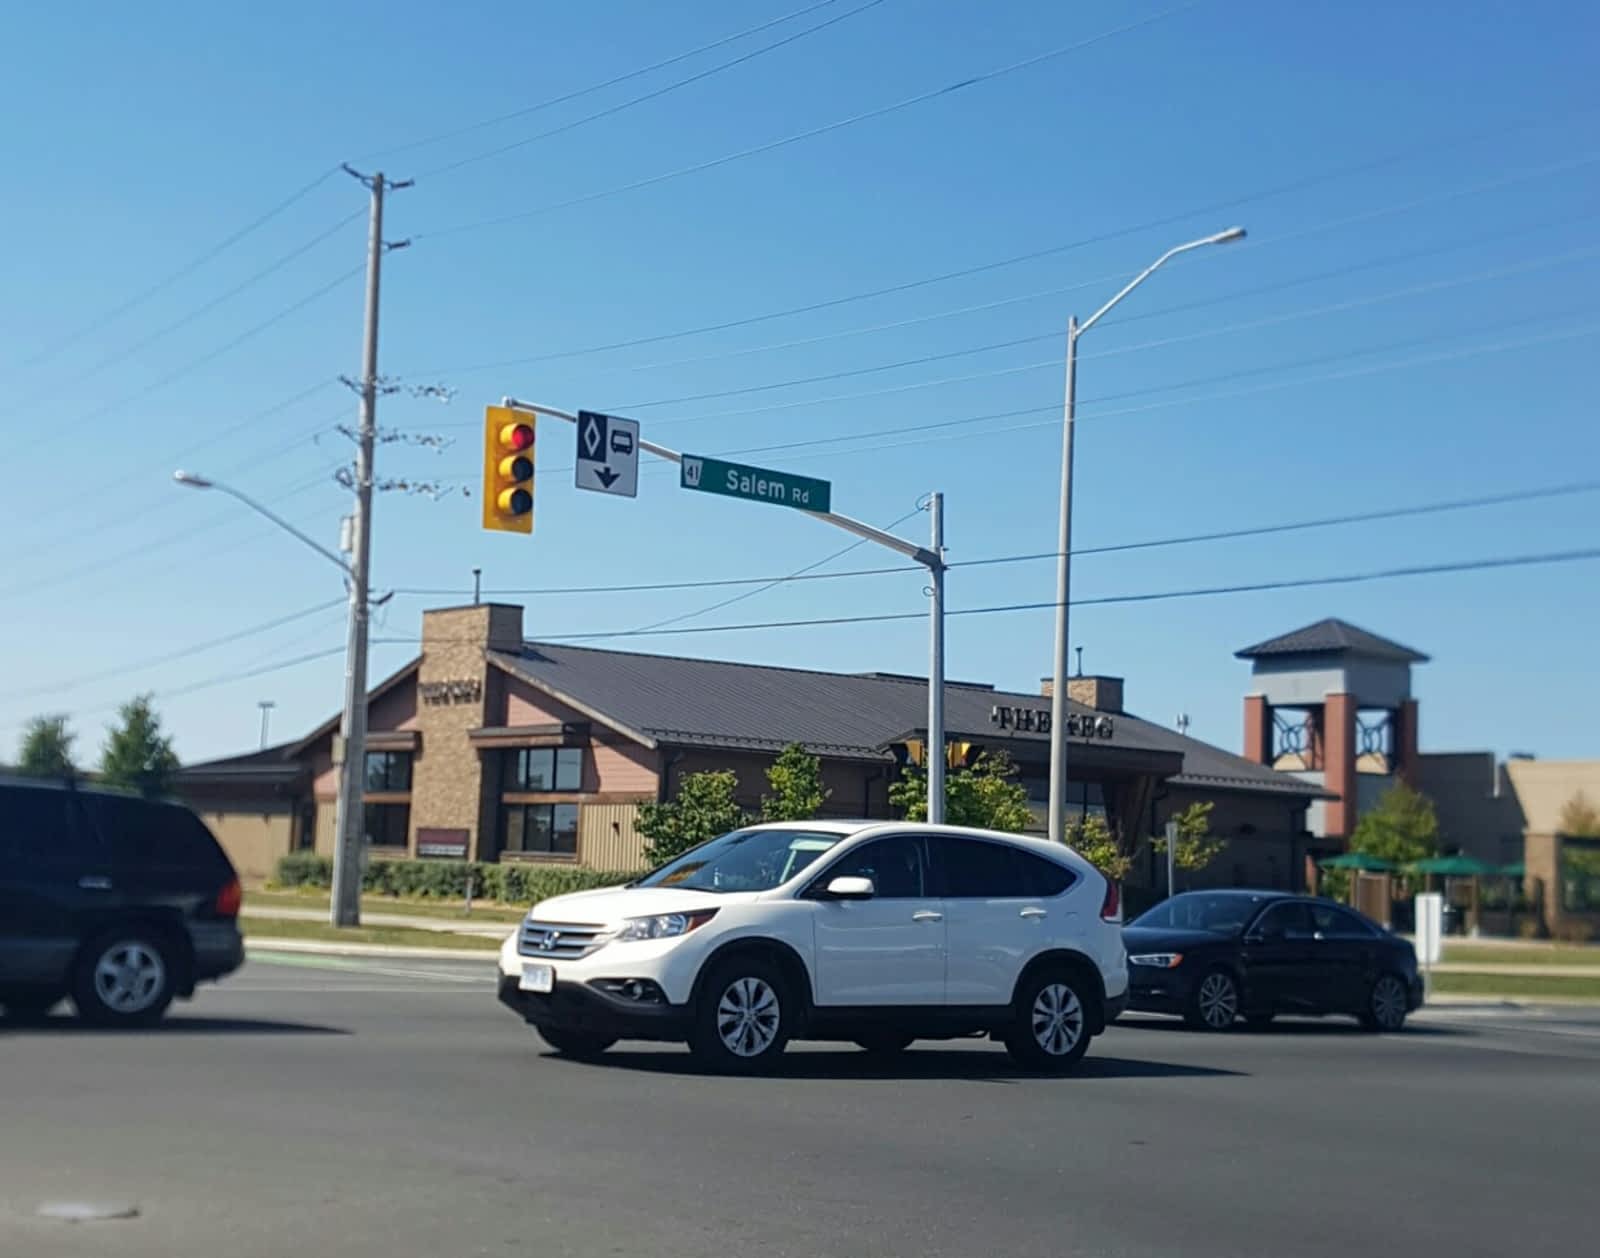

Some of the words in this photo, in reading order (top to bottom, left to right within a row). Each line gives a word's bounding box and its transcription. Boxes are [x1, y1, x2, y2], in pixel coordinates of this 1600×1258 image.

[686, 464, 699, 482] 41
[726, 469, 785, 499] Salem
[792, 487, 809, 503] Rd
[992, 705, 1052, 733] THE
